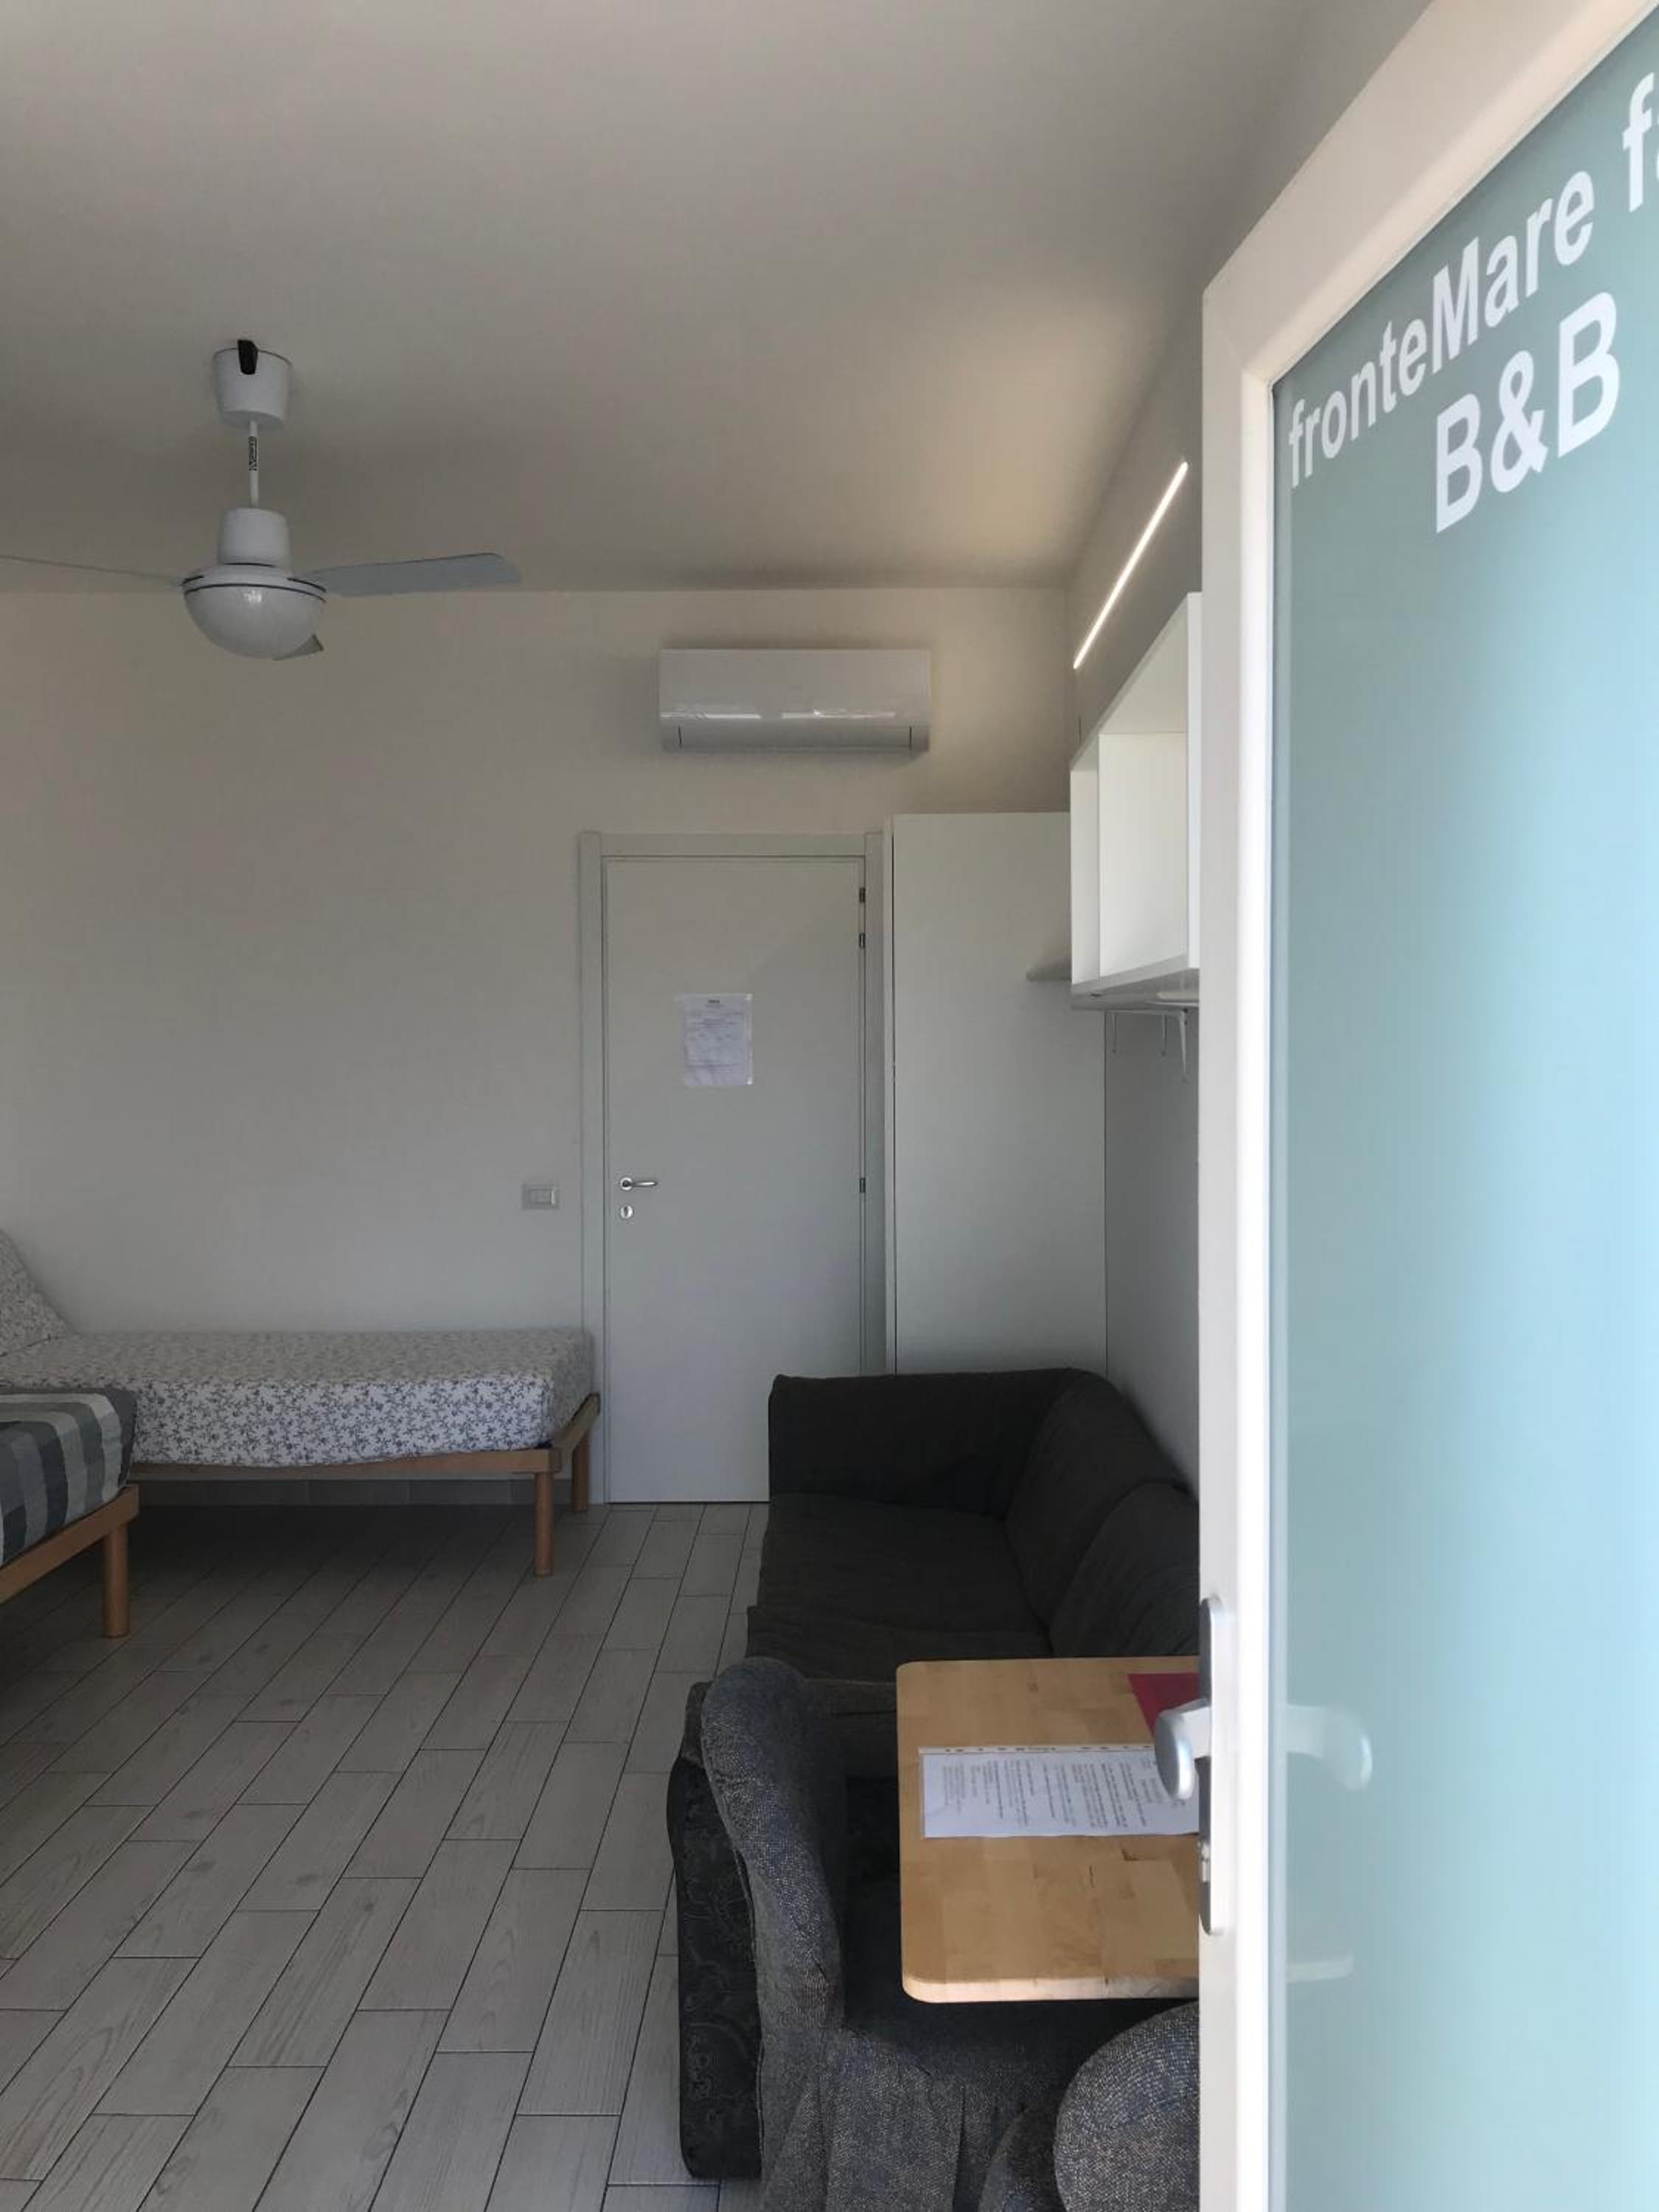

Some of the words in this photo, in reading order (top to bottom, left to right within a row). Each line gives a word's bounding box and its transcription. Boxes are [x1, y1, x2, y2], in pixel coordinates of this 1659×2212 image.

[1289, 170, 1595, 488] fronteMare
[1624, 72, 1659, 210] f
[1436, 291, 1621, 534] B&B
